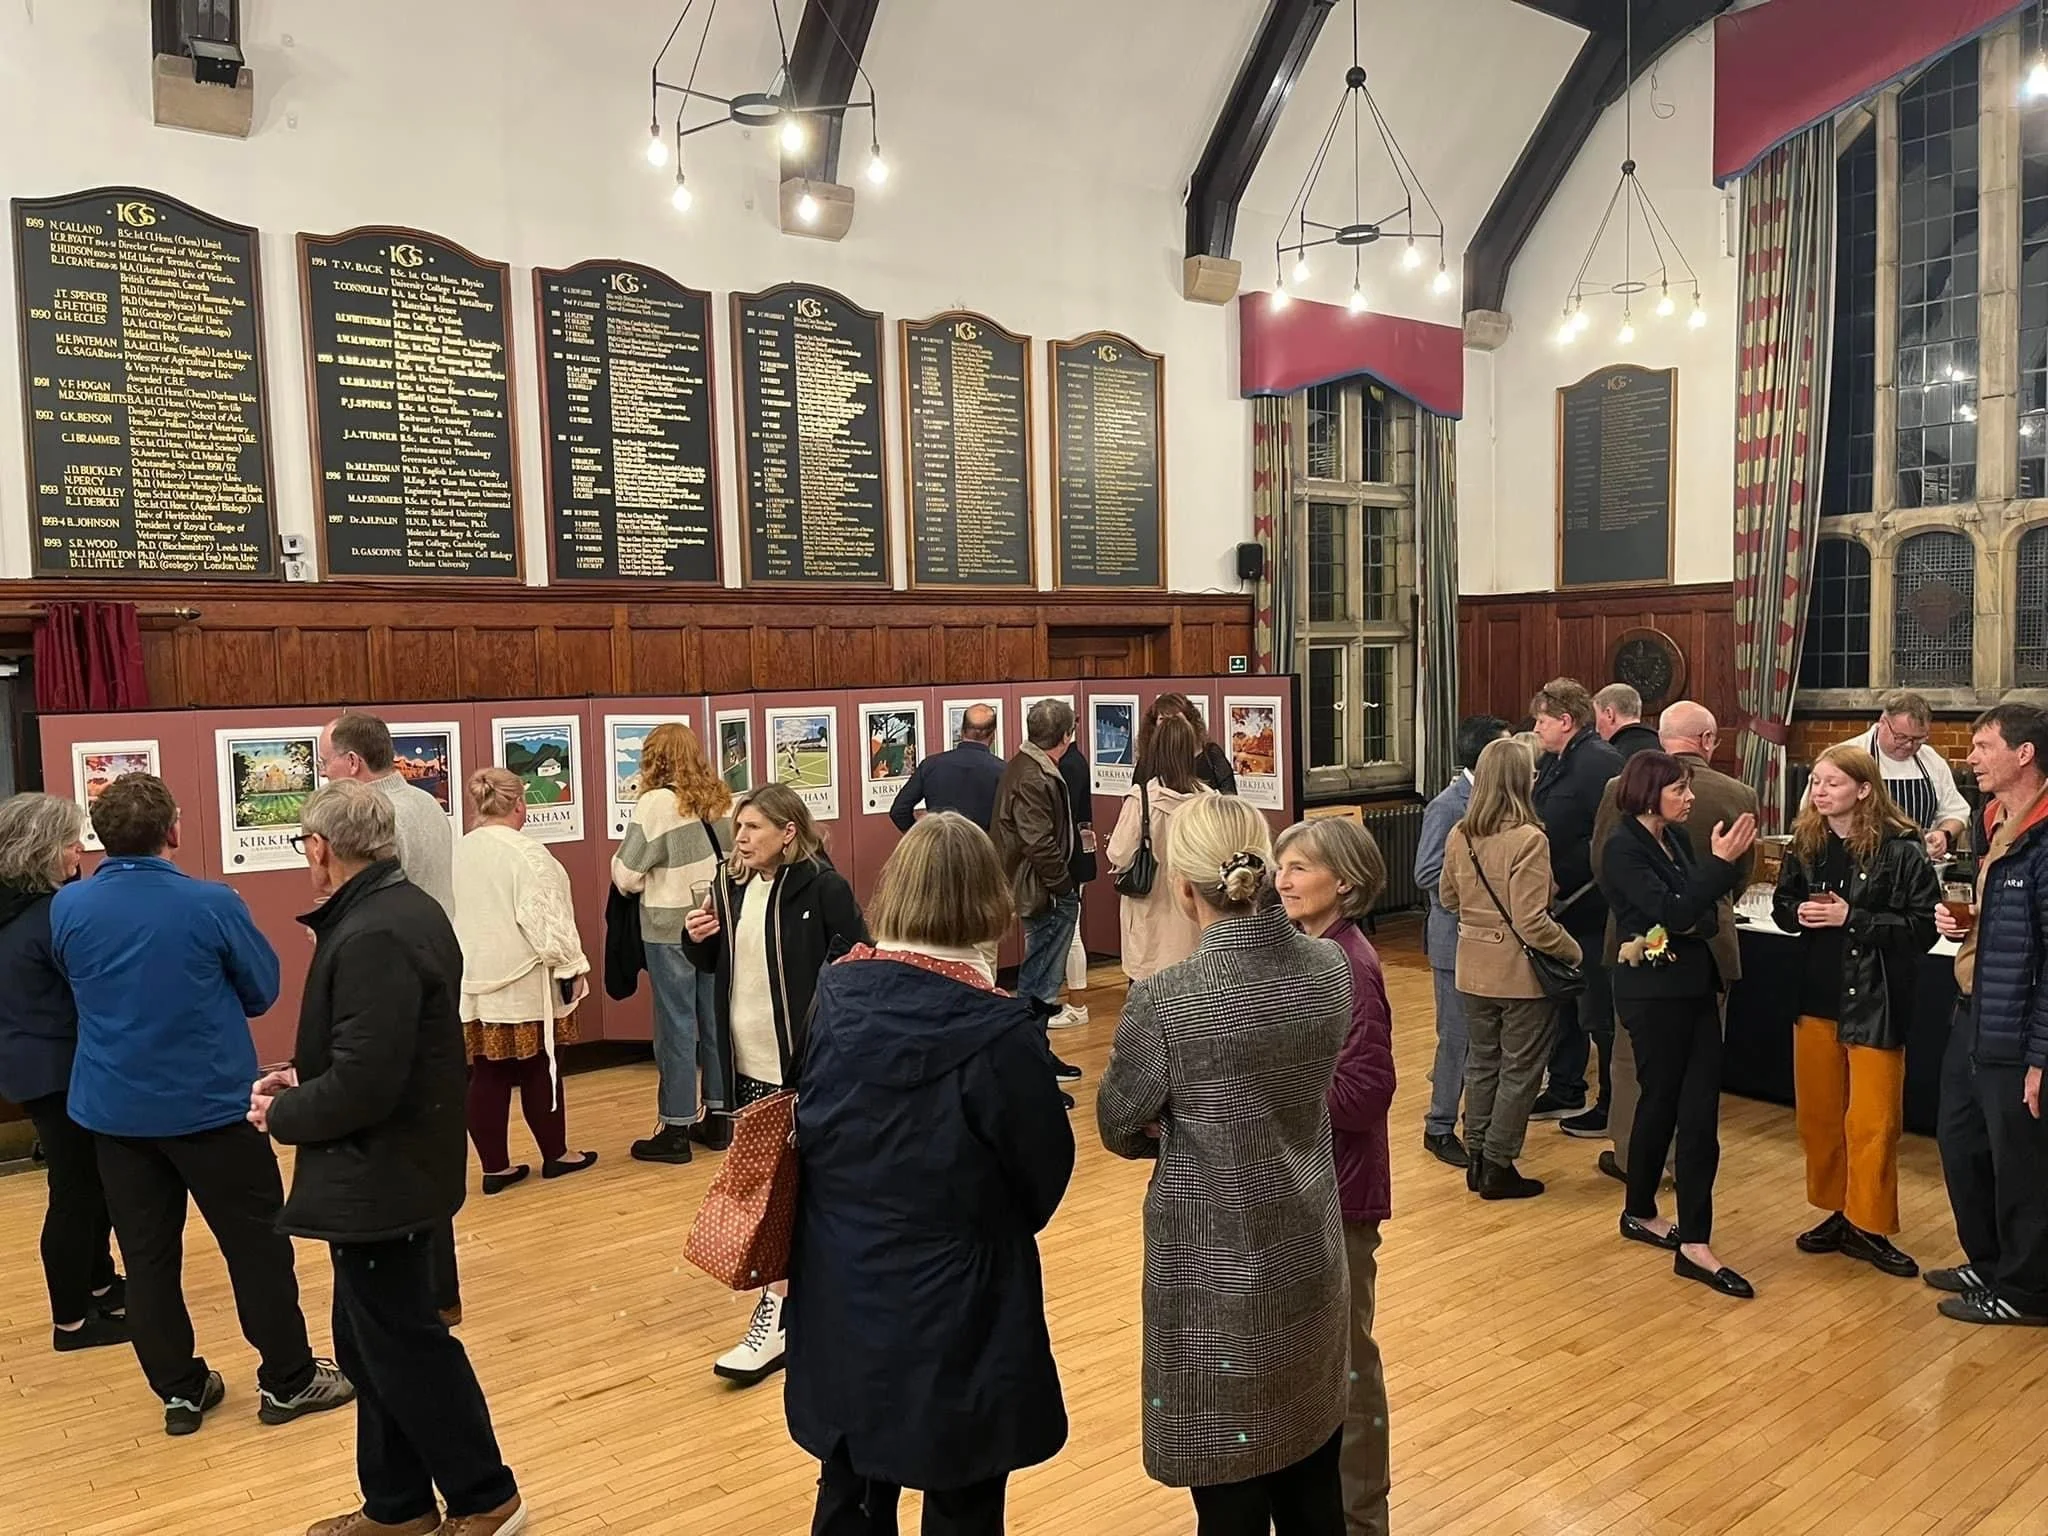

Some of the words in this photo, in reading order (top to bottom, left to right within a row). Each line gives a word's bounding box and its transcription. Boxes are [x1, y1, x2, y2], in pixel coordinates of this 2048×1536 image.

[118, 239, 148, 251] Director
[149, 243, 176, 255] General
[211, 250, 240, 262] Services
[70, 290, 108, 302] SPENCER
[124, 350, 160, 362] Professor
[170, 355, 216, 367] Agricultural
[133, 362, 150, 372] Vice
[126, 373, 161, 384] Awarded
[191, 410, 216, 421] School
[135, 519, 170, 529] President
[172, 521, 182, 530] of
[183, 521, 206, 531] Royal
[208, 522, 235, 533] College
[136, 530, 177, 541] Veterinary
[180, 531, 215, 542] Surgeons
[216, 542, 238, 551] Leeds
[203, 561, 233, 570] London
[872, 783, 902, 795] KIRKH
[525, 810, 571, 824] RKHAM
